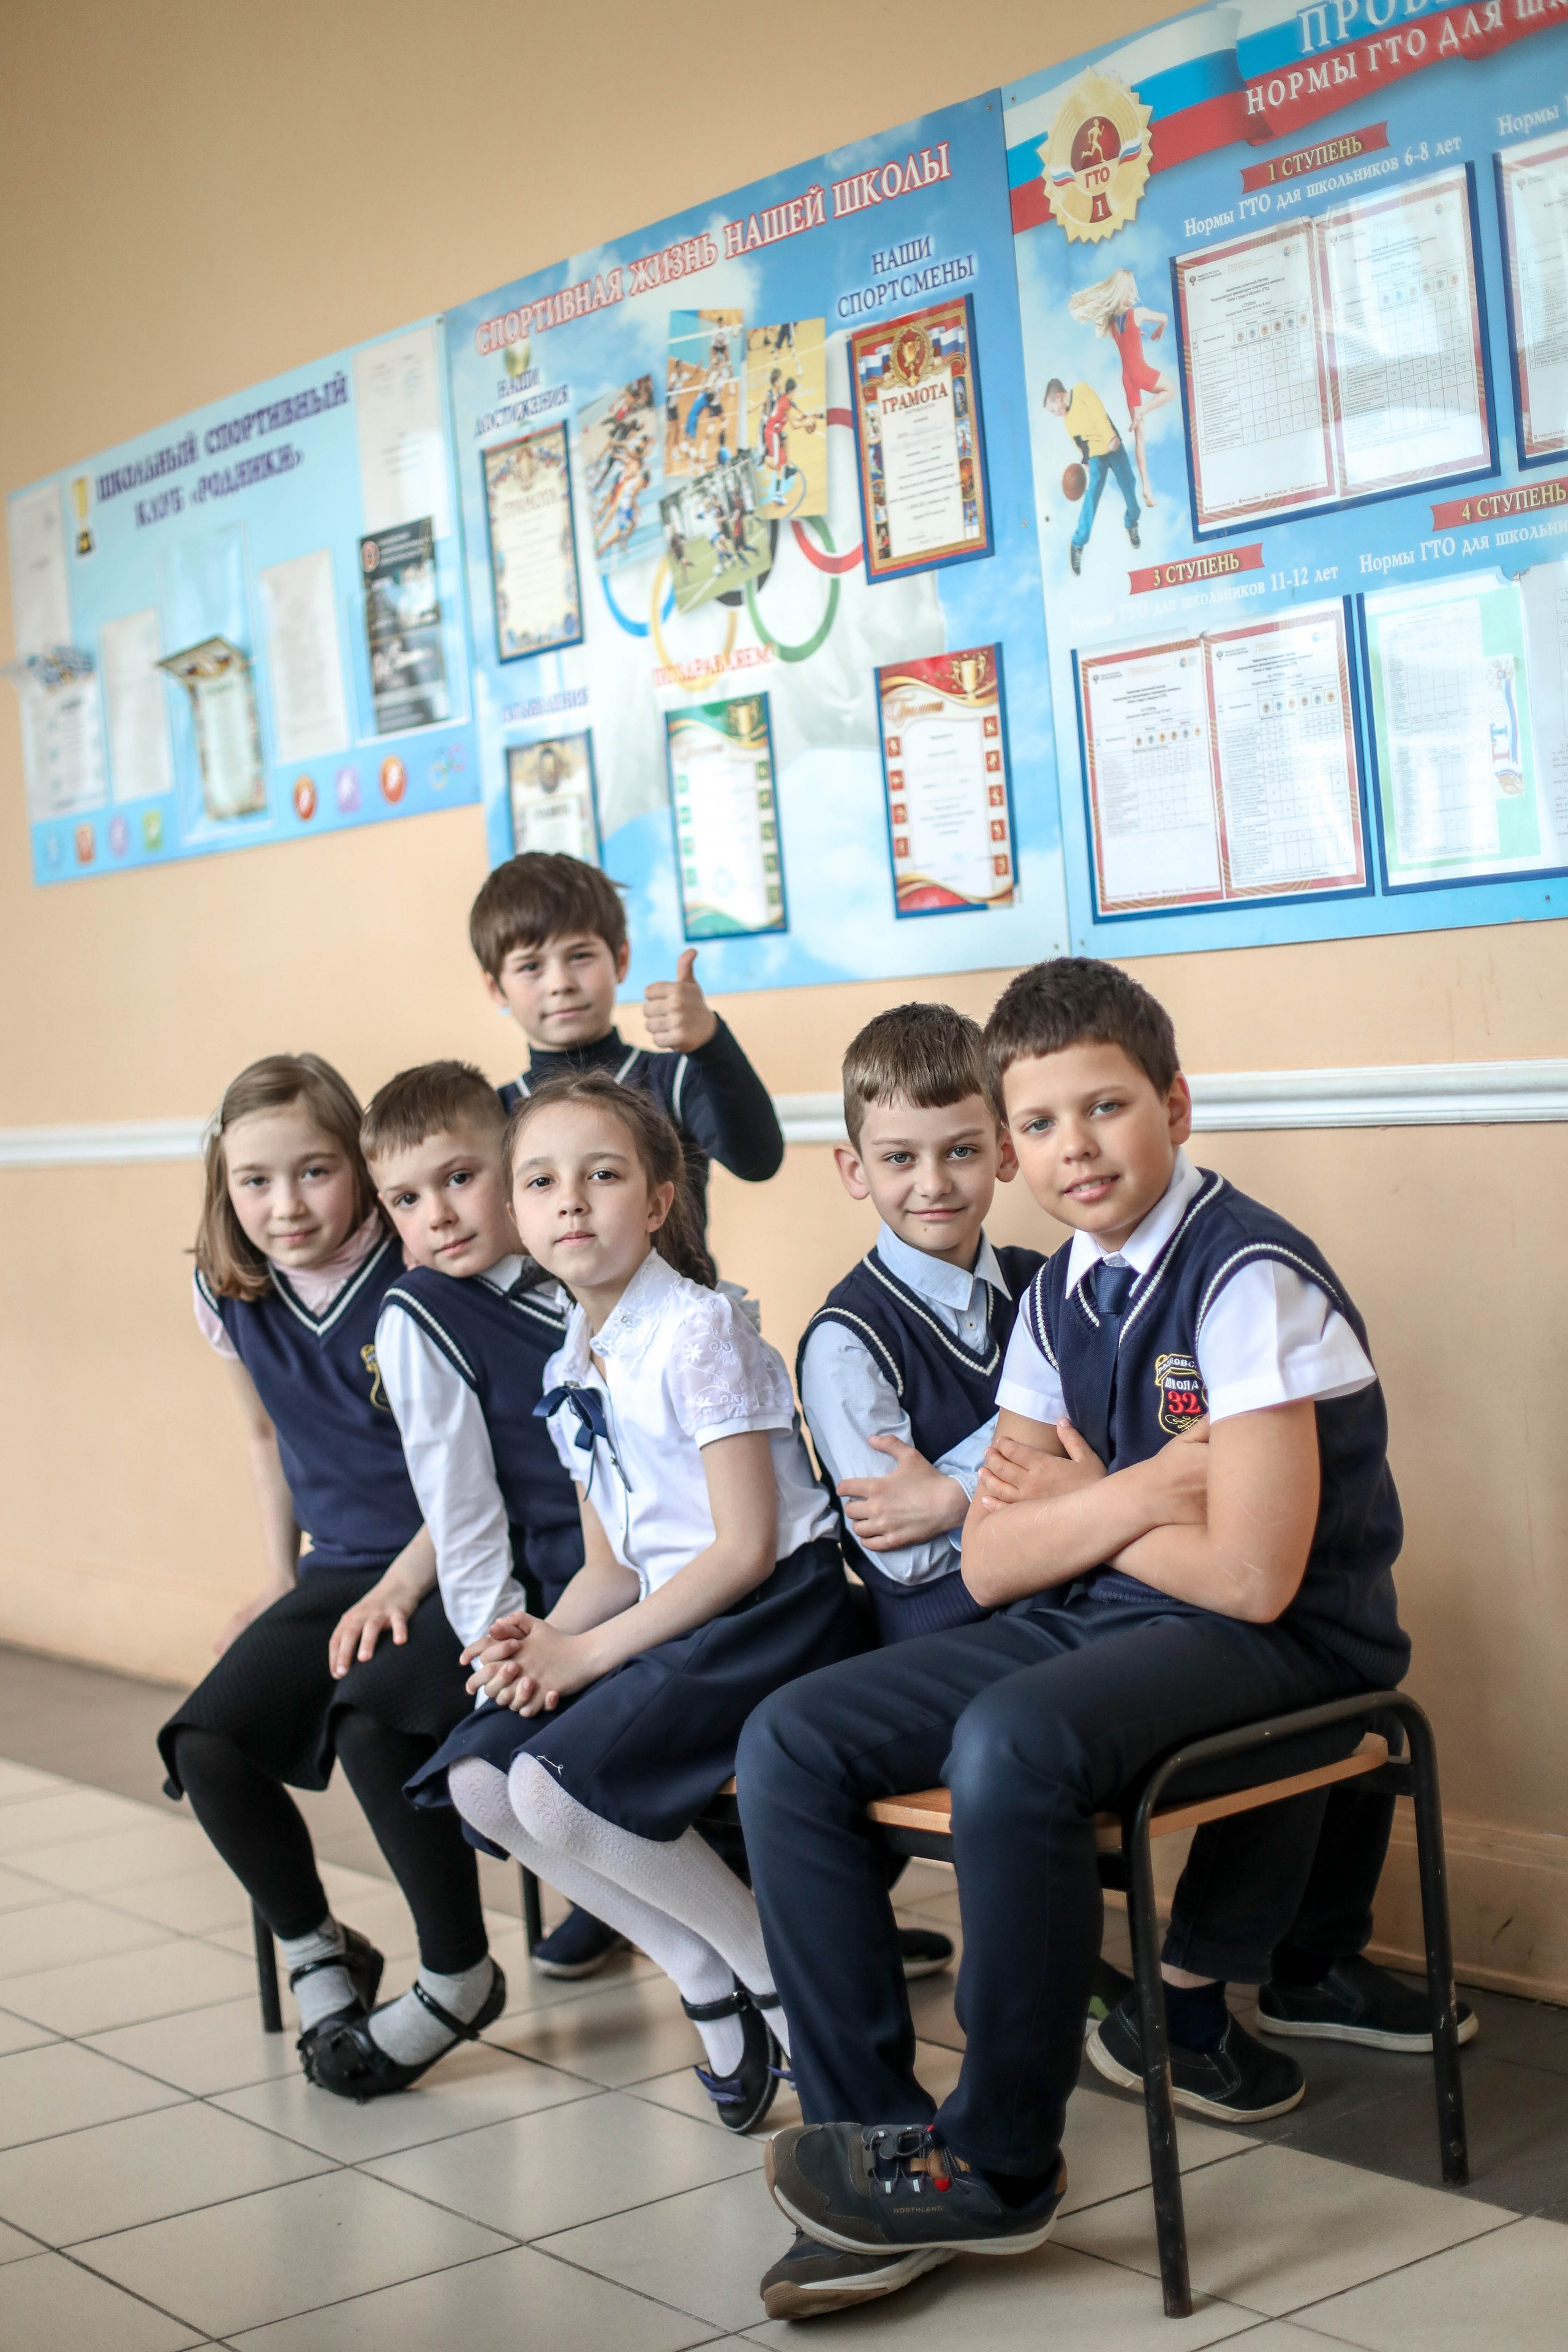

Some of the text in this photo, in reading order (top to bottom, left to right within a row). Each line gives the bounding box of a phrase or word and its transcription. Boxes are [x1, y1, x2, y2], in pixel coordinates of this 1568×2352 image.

[1246, 52, 1357, 115] НОРМЫ
[1367, 28, 1427, 72] ГТО
[1439, 0, 1504, 55] ДЛЯ
[1498, 105, 1560, 135] Нормы
[1085, 166, 1110, 188] ГТО
[1268, 135, 1362, 181] 1 СТУПЕНЬ
[1184, 136, 1462, 238] Нормы ГТО для школьников 6-8 лет
[1096, 200, 1104, 217] 1
[474, 140, 951, 355] СПОРТИВНАЯ ЖИЗНЬ НАШЕЙ ШКОЛЫ
[871, 235, 932, 275] НАШИ
[837, 255, 974, 318] СПОРТСМЕНЫ
[497, 366, 541, 400] НАШИ
[882, 382, 948, 415] ГРАМОТА
[96, 431, 198, 502] ШКОЛЬНЫЙ
[204, 370, 349, 455] СПОРТИВНЫЙ
[135, 486, 183, 527] КЛУБ
[1462, 483, 1567, 521] 4 СТУПЕНЬ
[1153, 553, 1240, 587] 3 СТУПЕНЬ
[1359, 550, 1415, 575] Нормы
[1419, 537, 1456, 561] ГТО
[1462, 535, 1490, 557] для
[1119, 600, 1149, 622] ГТО
[1182, 581, 1265, 609] школьников
[1270, 568, 1310, 592] 11-12
[1314, 566, 1338, 583] лет
[1165, 1376, 1199, 1390] ШКОЛА
[1167, 1390, 1201, 1414] 32
